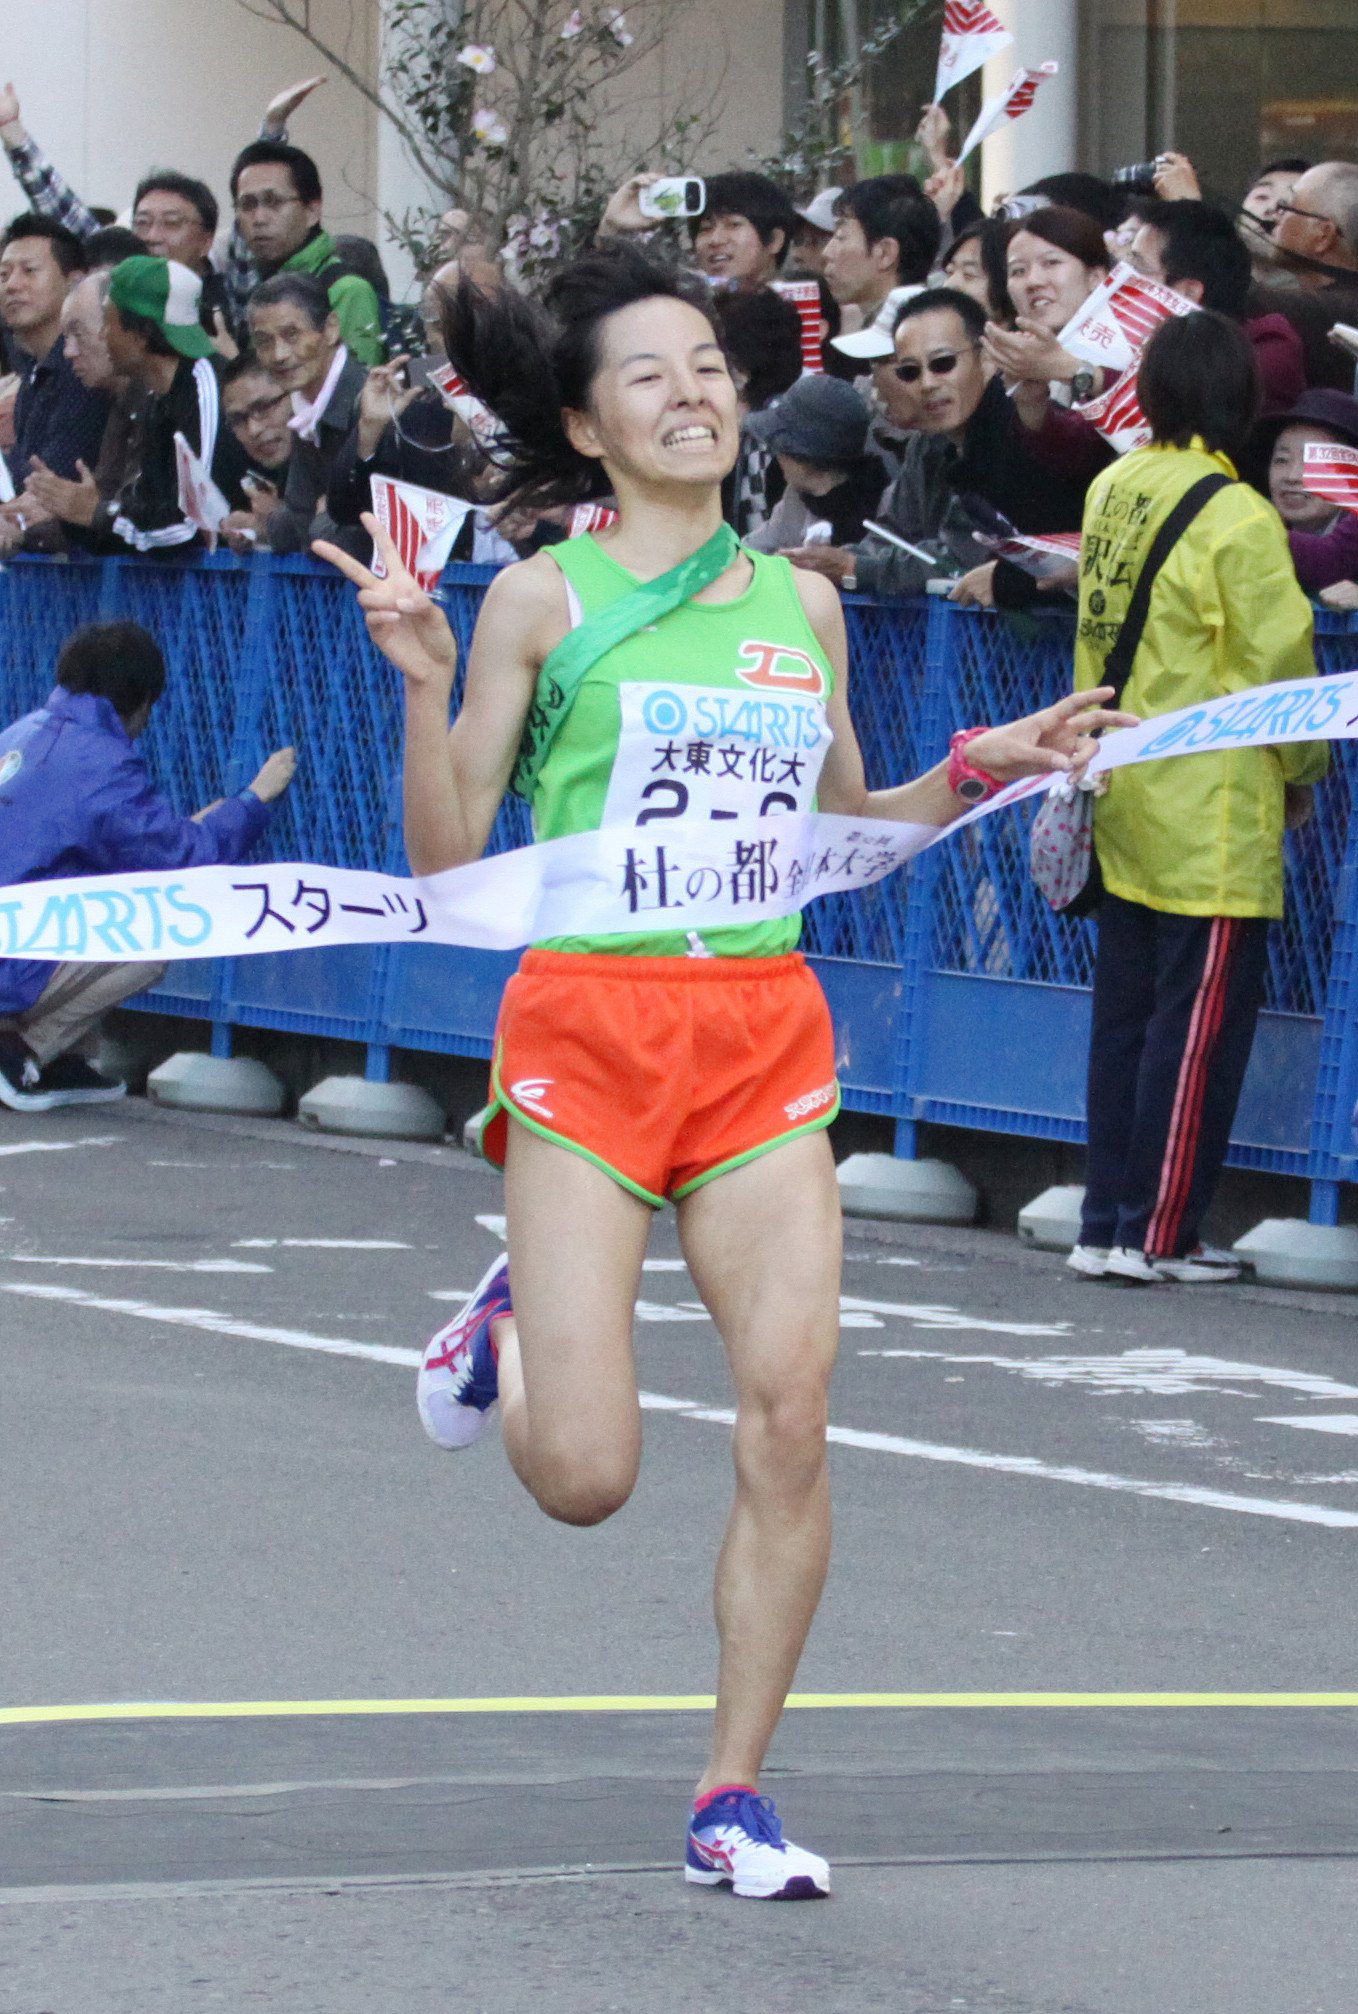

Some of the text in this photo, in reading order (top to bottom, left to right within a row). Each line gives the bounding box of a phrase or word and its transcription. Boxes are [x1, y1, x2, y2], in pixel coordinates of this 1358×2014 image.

[693, 697, 822, 750] STARTS
[651, 740, 806, 788] 大東文化大
[0, 879, 428, 955] TARTS スターツ
